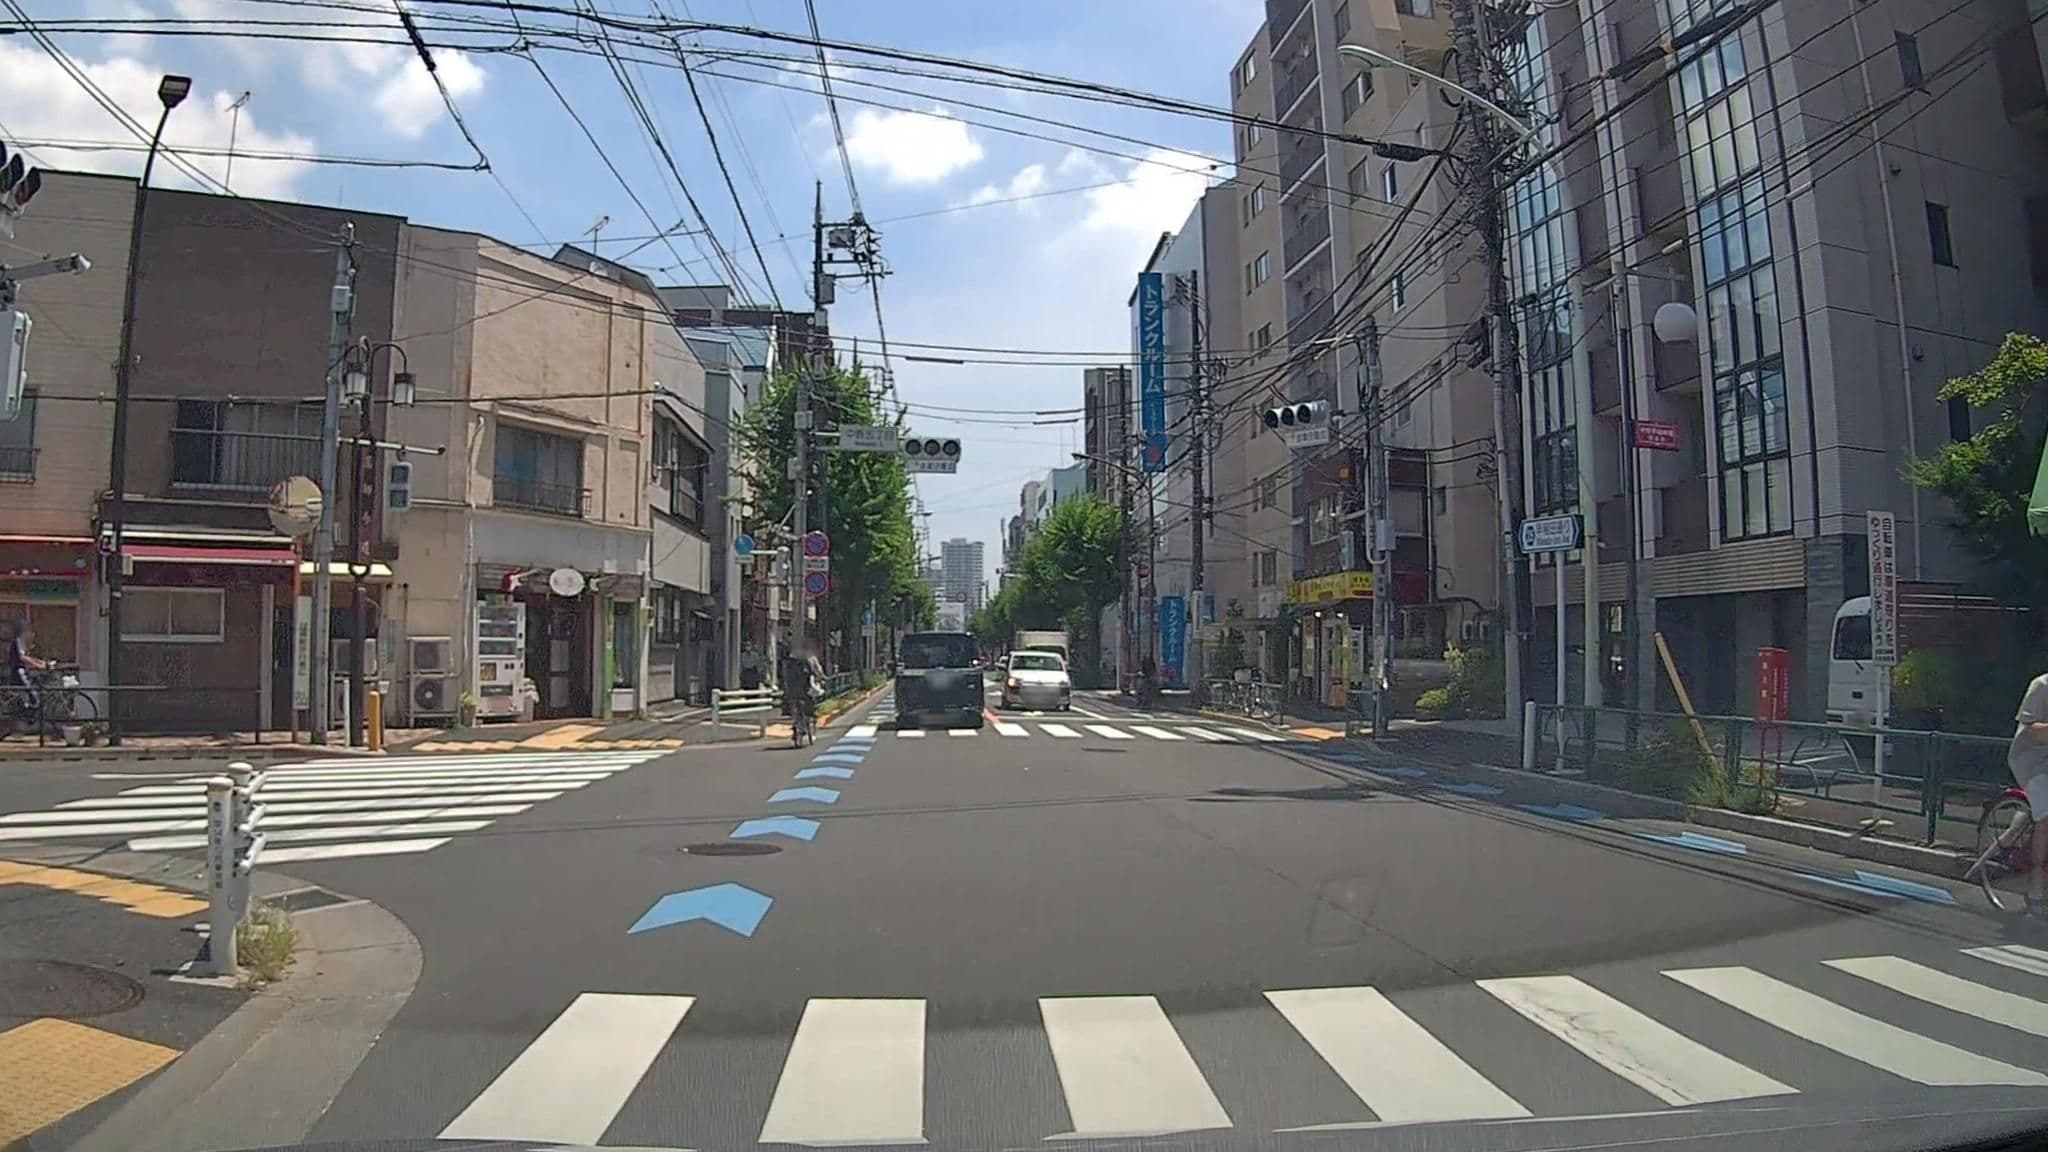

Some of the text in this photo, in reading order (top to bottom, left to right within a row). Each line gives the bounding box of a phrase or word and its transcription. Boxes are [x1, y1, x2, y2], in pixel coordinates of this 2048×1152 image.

[1143, 283, 1162, 393] トランクルーム
